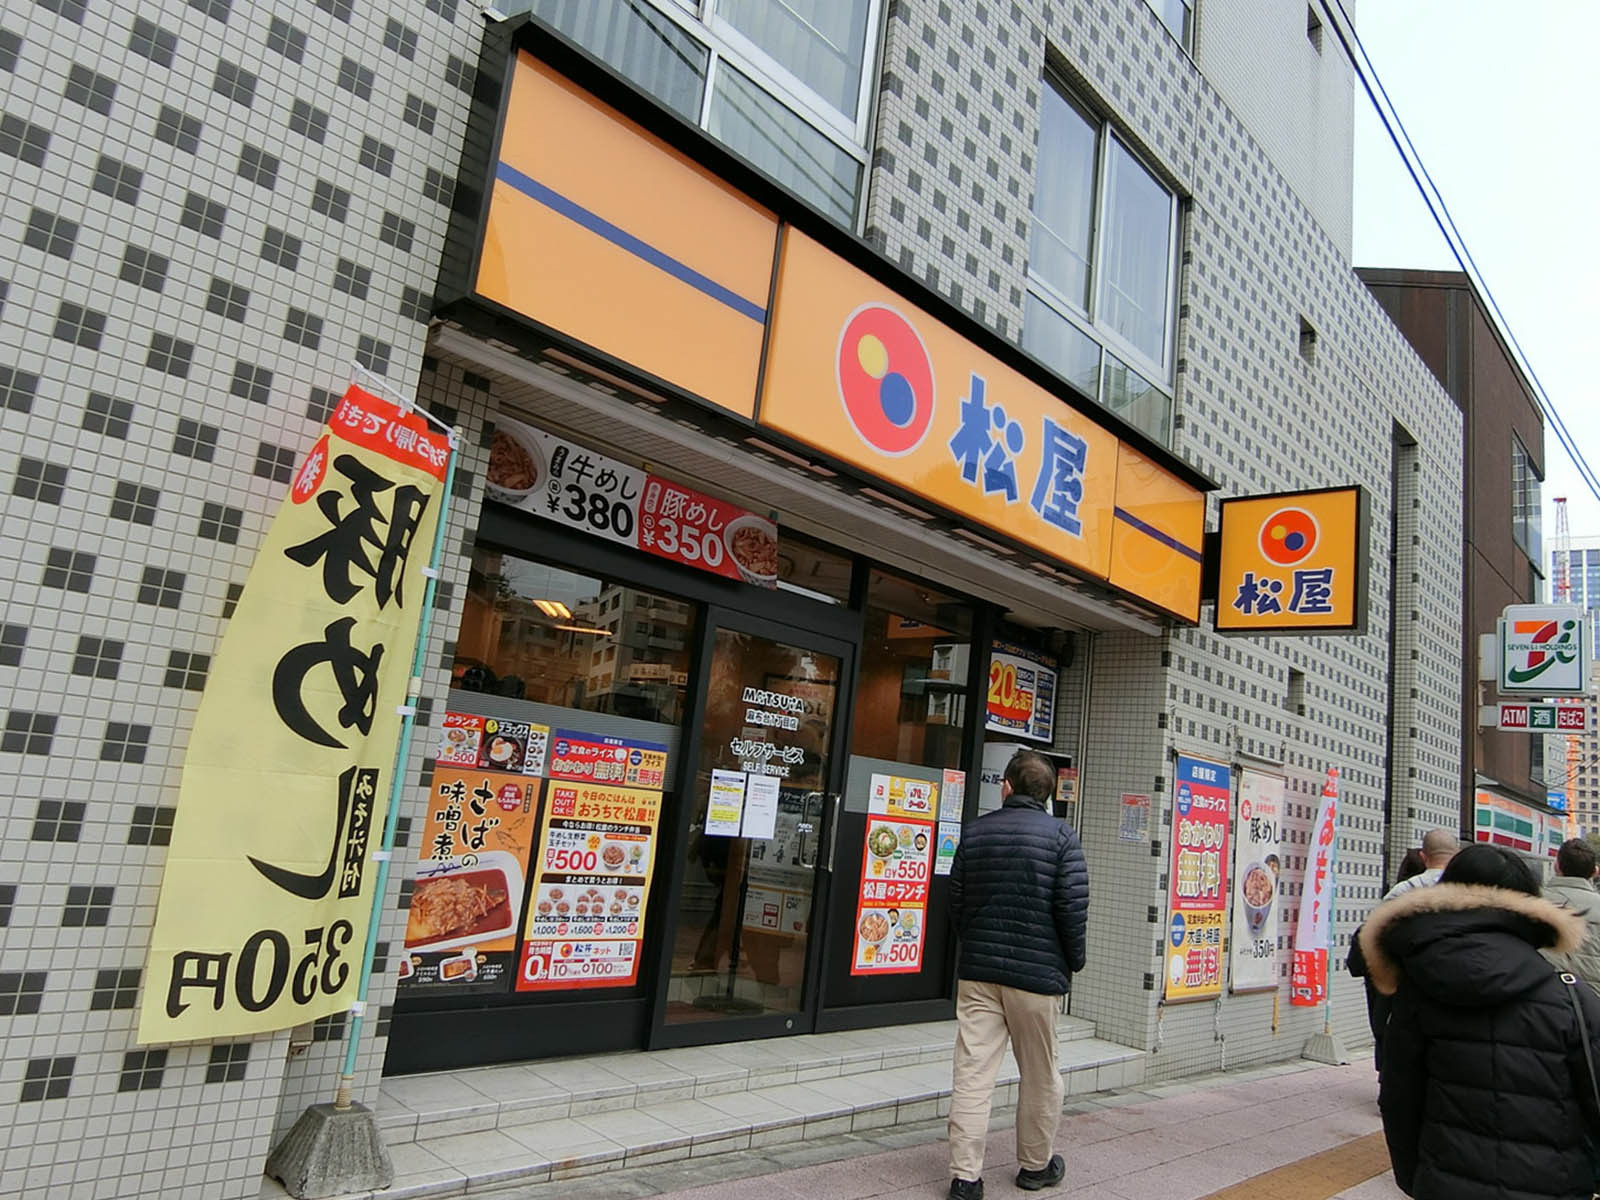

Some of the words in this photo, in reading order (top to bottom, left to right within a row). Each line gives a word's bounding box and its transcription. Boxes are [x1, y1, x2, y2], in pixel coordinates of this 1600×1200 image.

[947, 371, 1089, 539] 松屋
[568, 455, 637, 500] 牛めし
[547, 484, 634, 538] ¥380
[660, 488, 723, 531] 豚めし
[643, 518, 723, 567] ¥350
[1232, 567, 1335, 616] 松屋
[1503, 709, 1526, 724] ATM
[1533, 709, 1551, 726] 酒
[1558, 710, 1584, 727] たばこ
[730, 737, 804, 765] セルフサービス
[743, 761, 761, 773] SELF
[761, 763, 790, 777] SERVICE
[556, 789, 576, 799] TAKE
[432, 780, 466, 860] 味噌煮
[461, 780, 499, 866] さばの
[1179, 818, 1224, 849] おかわり
[1249, 817, 1280, 844] 豚めし
[863, 881, 925, 900] 松屋のランチ
[1176, 848, 1220, 898] 無料
[1185, 947, 1219, 987] 無料
